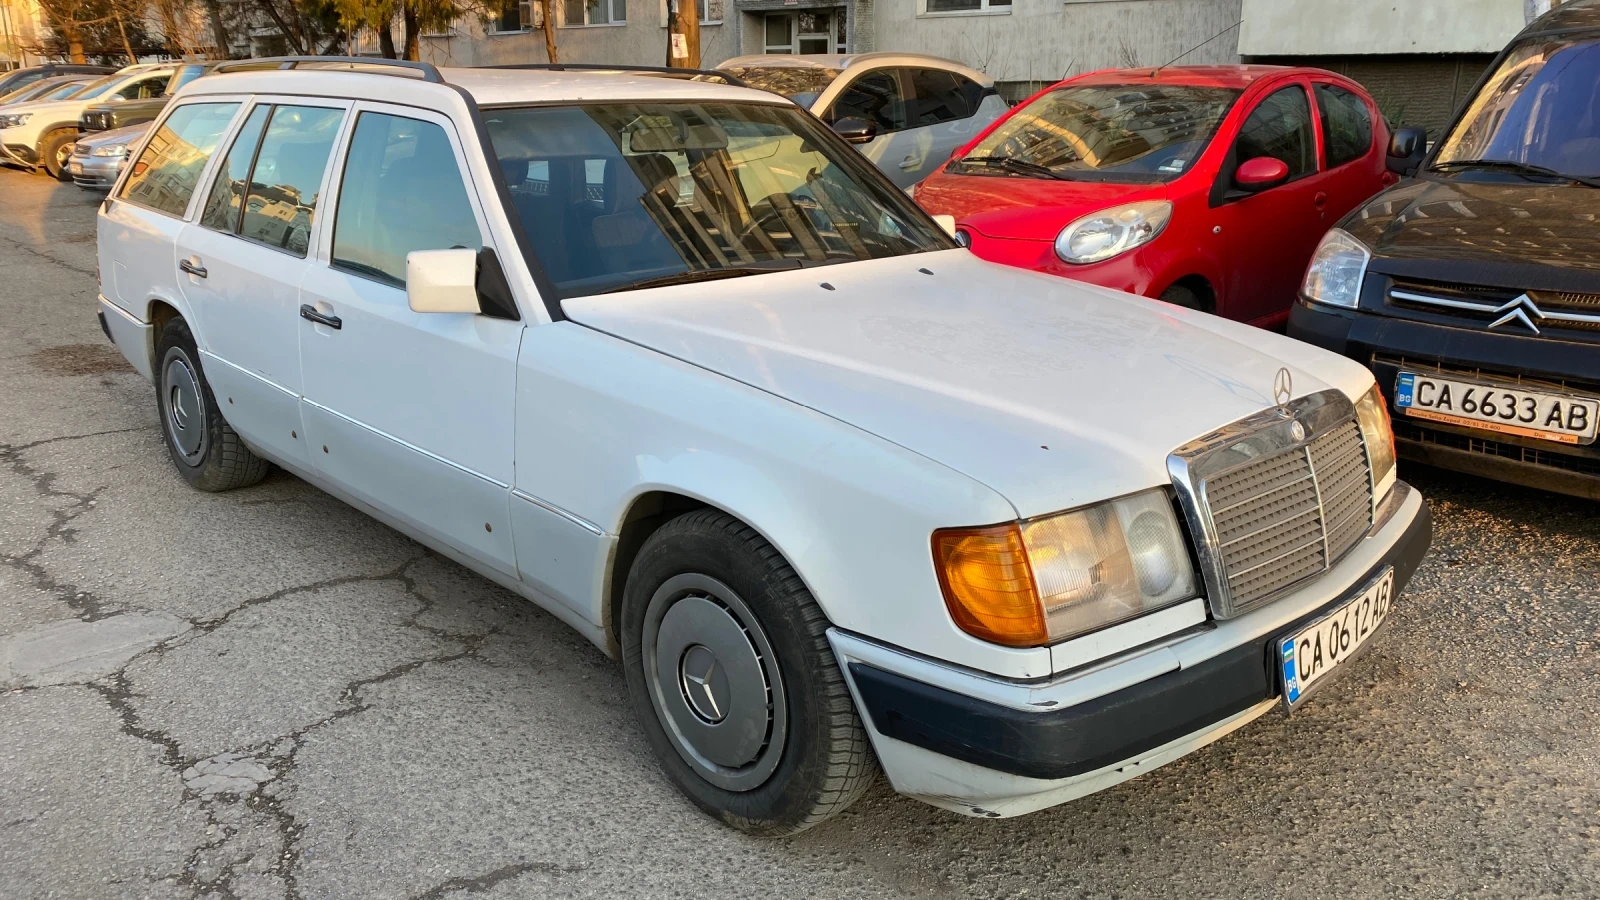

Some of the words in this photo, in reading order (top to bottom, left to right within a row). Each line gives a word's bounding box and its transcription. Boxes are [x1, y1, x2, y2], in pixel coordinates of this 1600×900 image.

[1399, 393, 1412, 403] BG
[1417, 380, 1453, 410] CA
[1461, 388, 1537, 423] 6633
[1544, 401, 1588, 431] AB
[1298, 630, 1323, 682] CA
[1329, 597, 1370, 660] 0612
[1372, 580, 1389, 627] AB
[1287, 676, 1297, 692] BG
